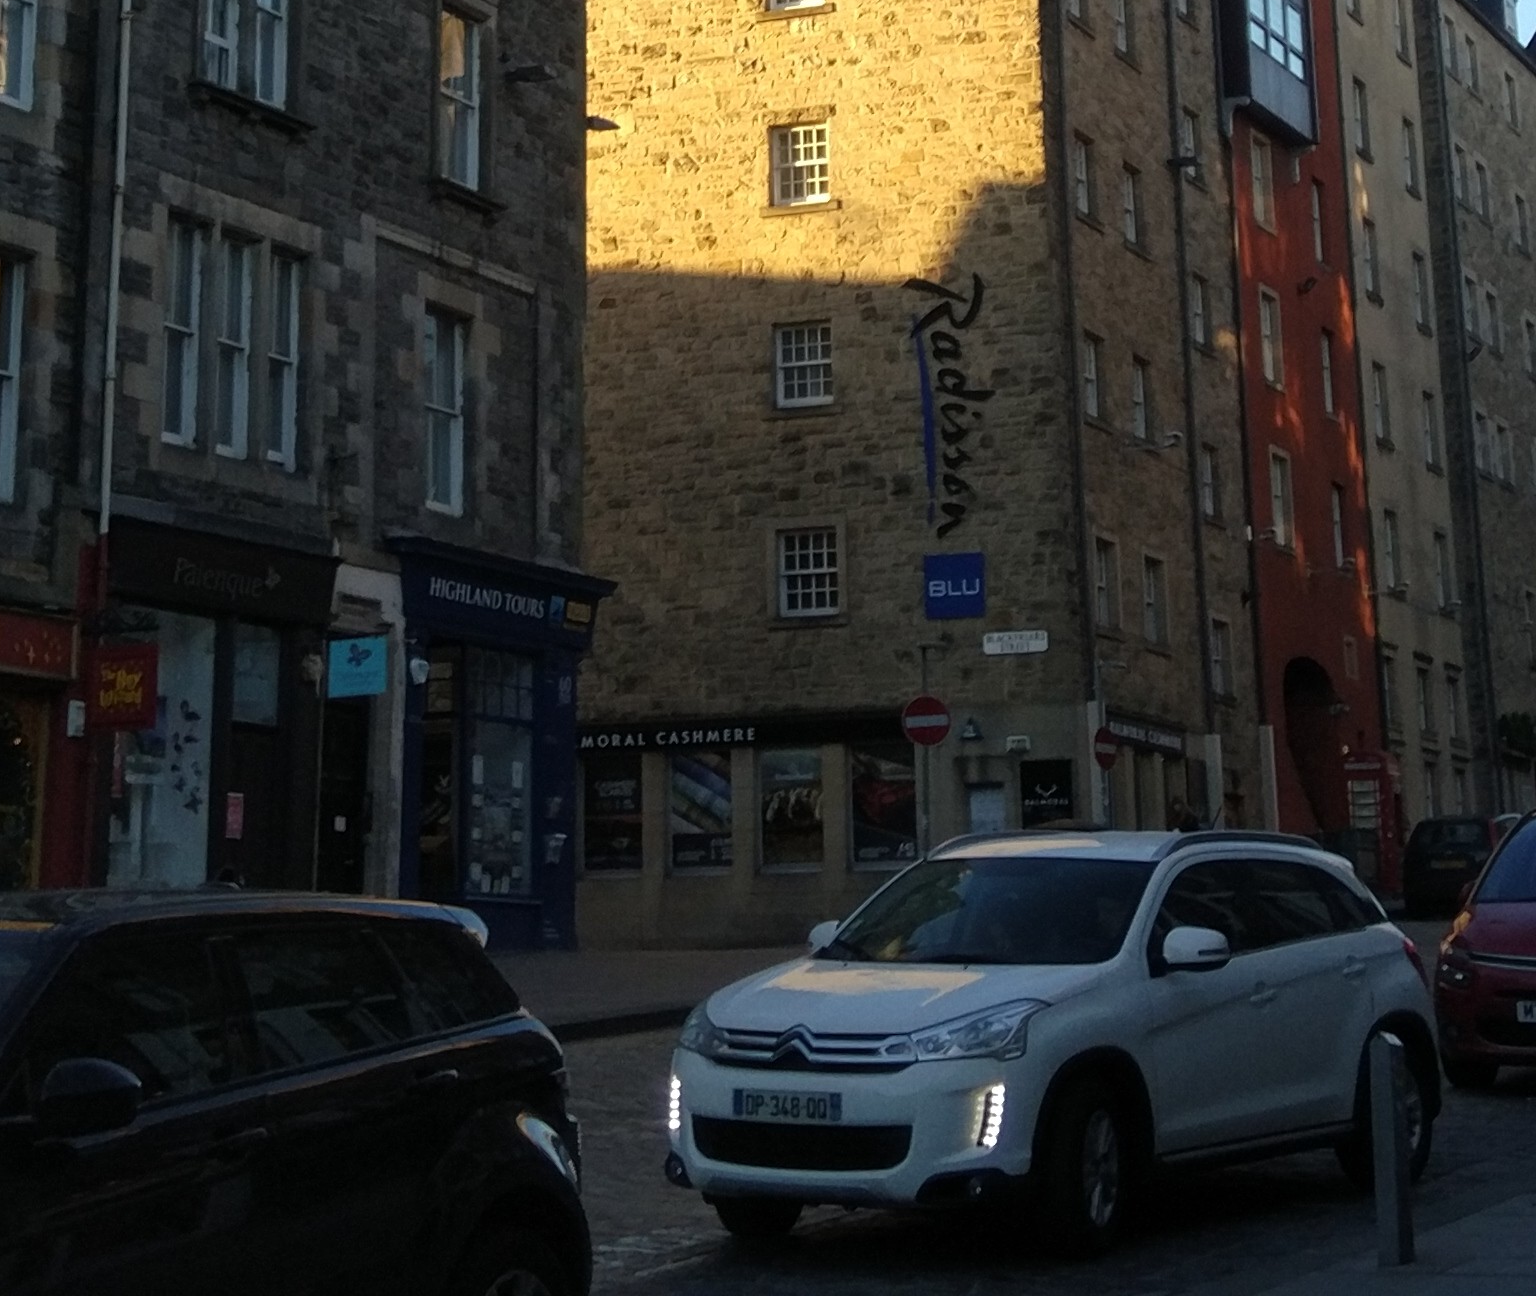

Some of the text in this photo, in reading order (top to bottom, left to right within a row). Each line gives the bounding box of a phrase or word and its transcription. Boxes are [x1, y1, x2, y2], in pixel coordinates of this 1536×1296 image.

[900, 271, 997, 540] Radisson
[173, 556, 266, 600] Palenque
[928, 578, 981, 598] BLU
[429, 576, 503, 611] HIGHLAND
[504, 592, 546, 620] TOURS
[115, 669, 144, 692] Boy
[578, 727, 756, 749] MORAL CASHMERE
